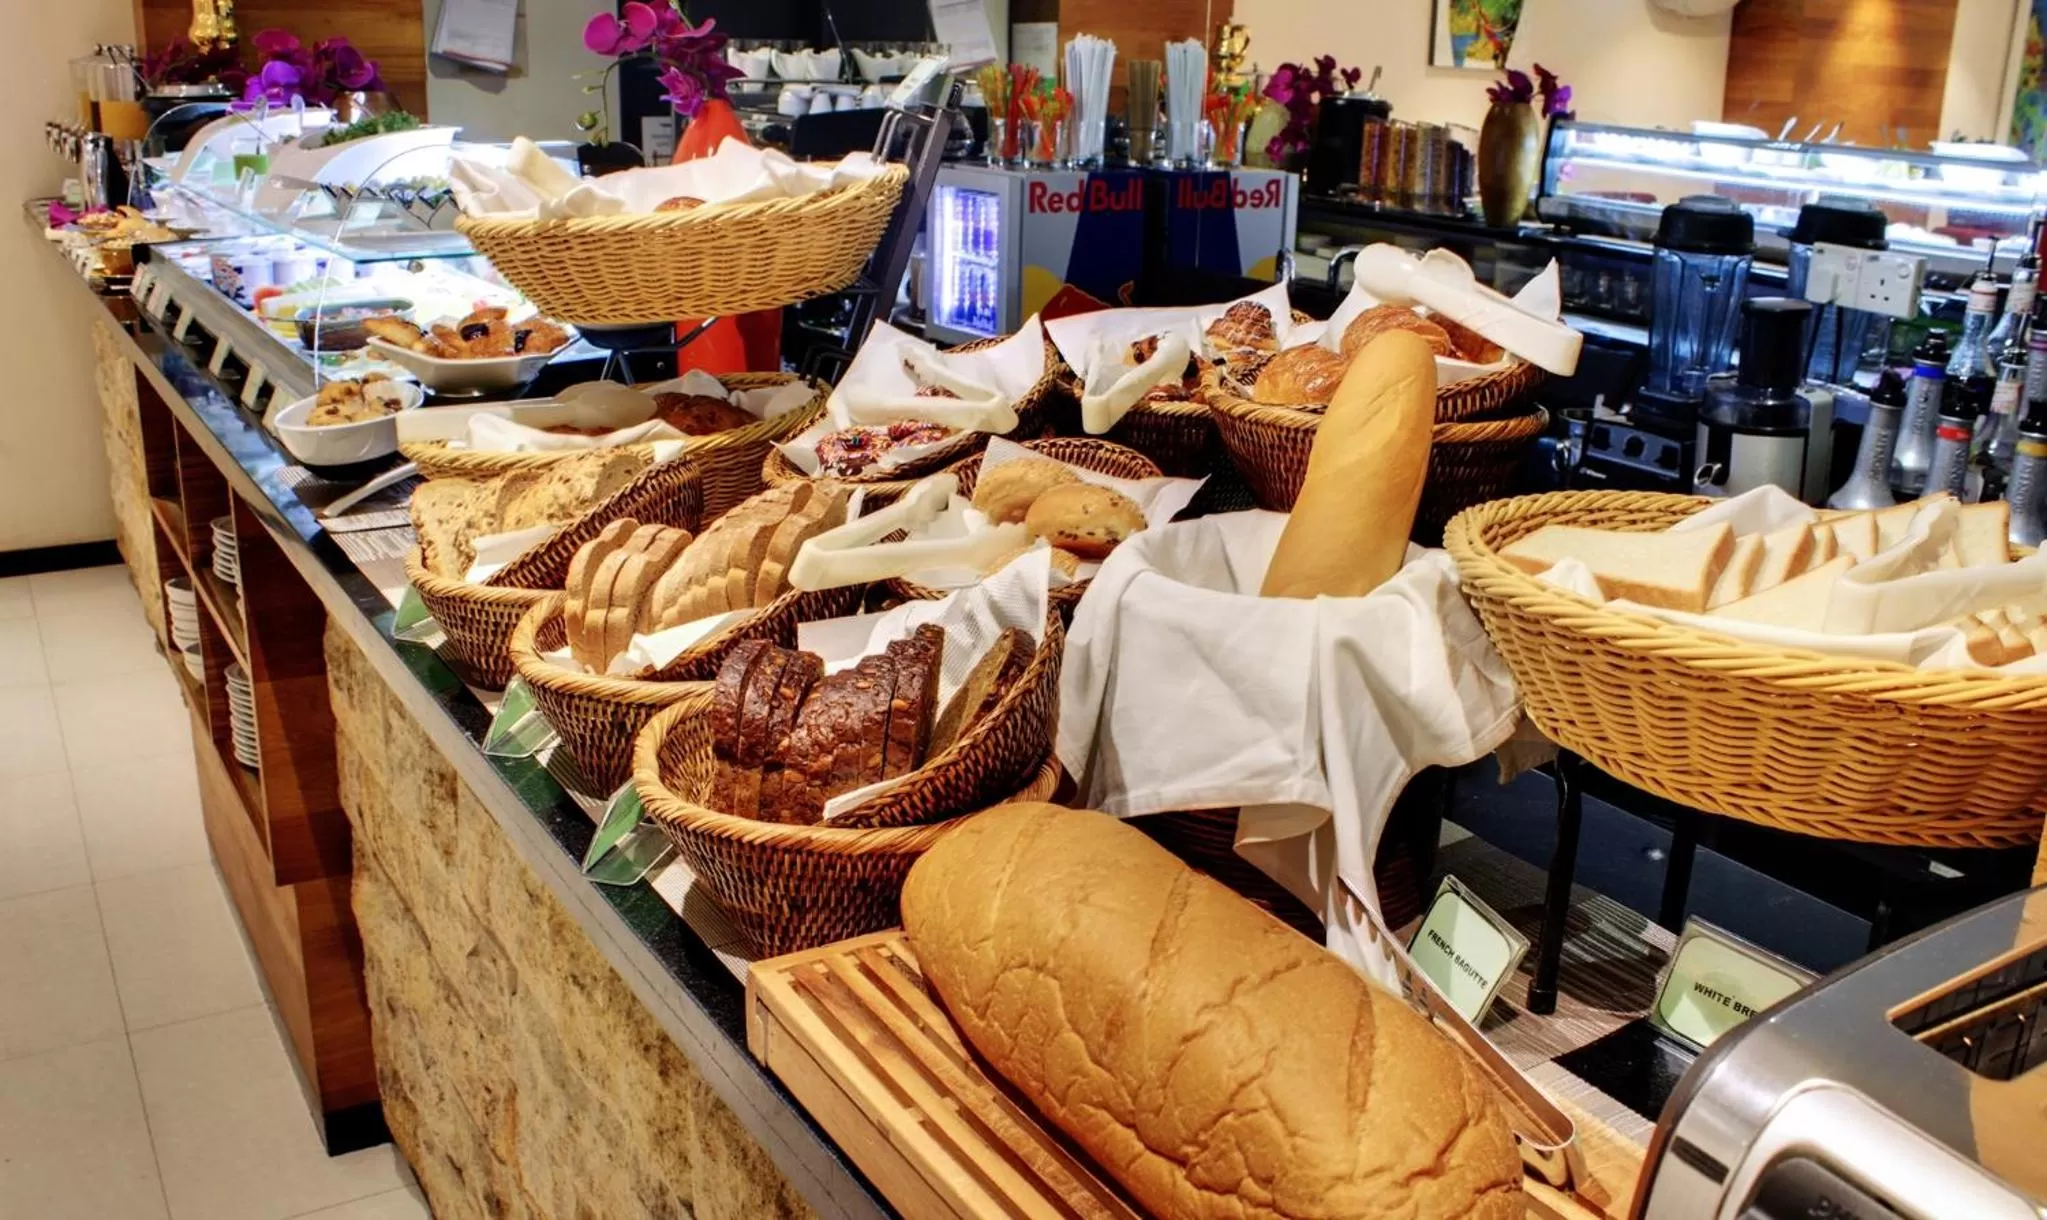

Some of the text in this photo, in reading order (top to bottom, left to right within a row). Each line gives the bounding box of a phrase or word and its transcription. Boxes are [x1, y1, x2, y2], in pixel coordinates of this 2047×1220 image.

[1029, 176, 1143, 214] Red Bull
[1427, 929, 1488, 989] FRENCH BAGUTTE
[1694, 982, 1732, 1007] WHITE
